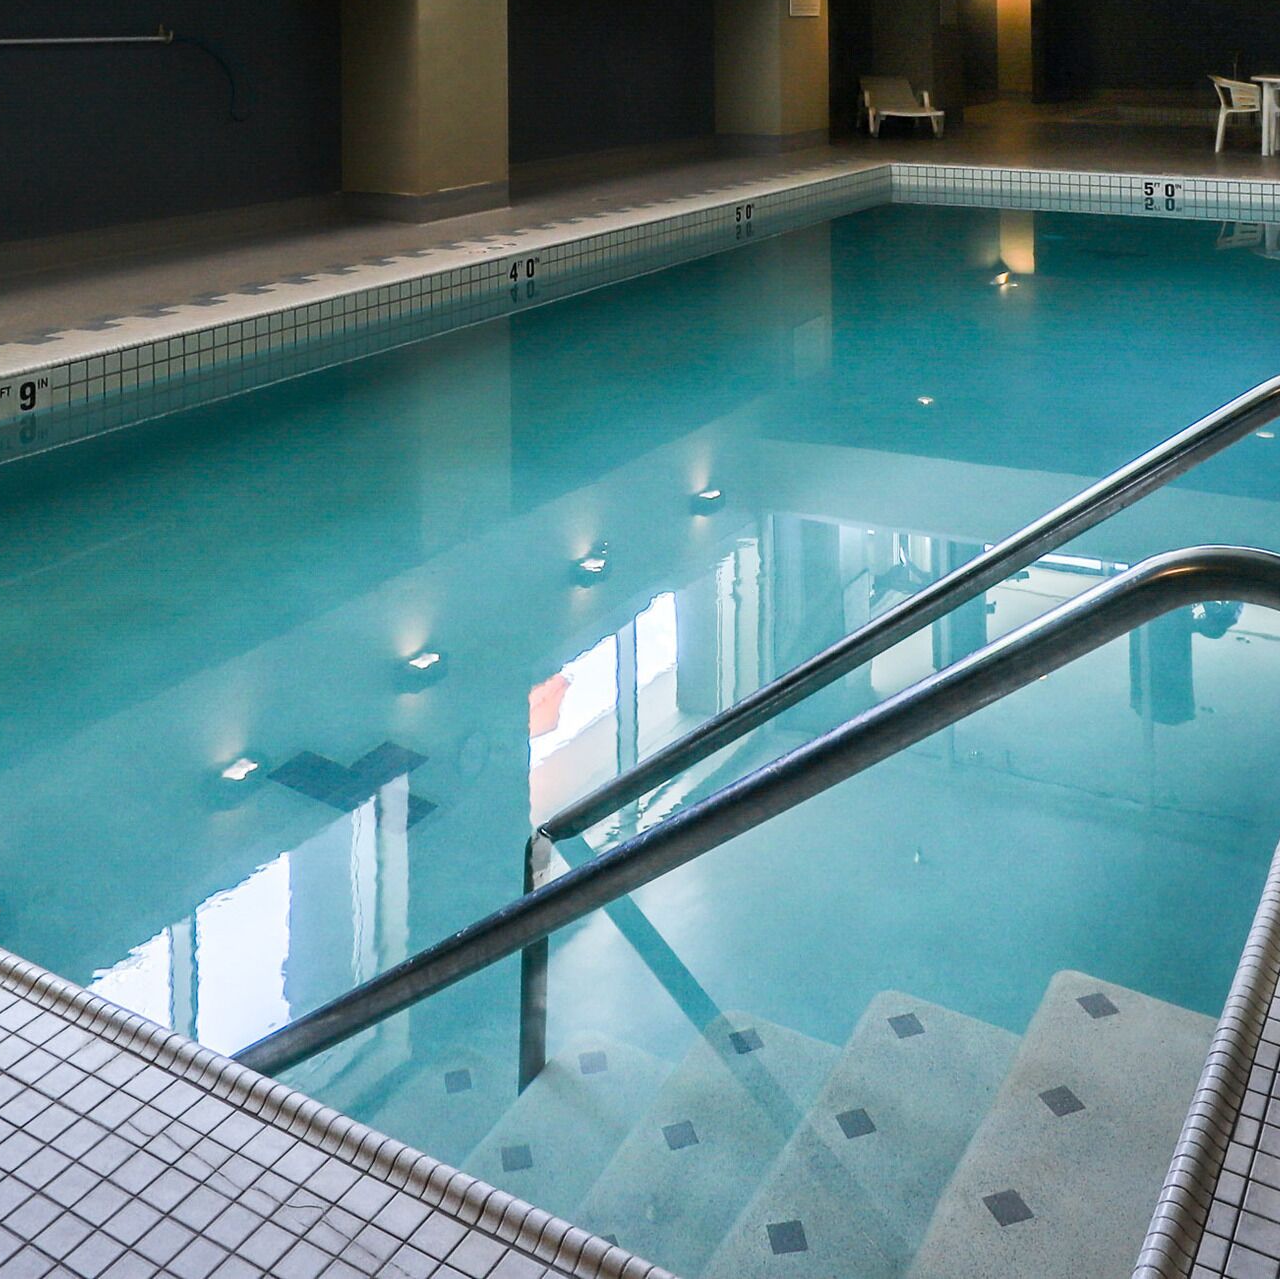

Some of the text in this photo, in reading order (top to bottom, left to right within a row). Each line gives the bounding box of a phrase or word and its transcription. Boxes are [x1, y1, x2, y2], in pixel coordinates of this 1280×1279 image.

[1144, 182, 1154, 196] 5
[1165, 183, 1175, 197] 0
[510, 262, 519, 282] 4
[526, 258, 535, 278] 0
[20, 381, 37, 411] 9
